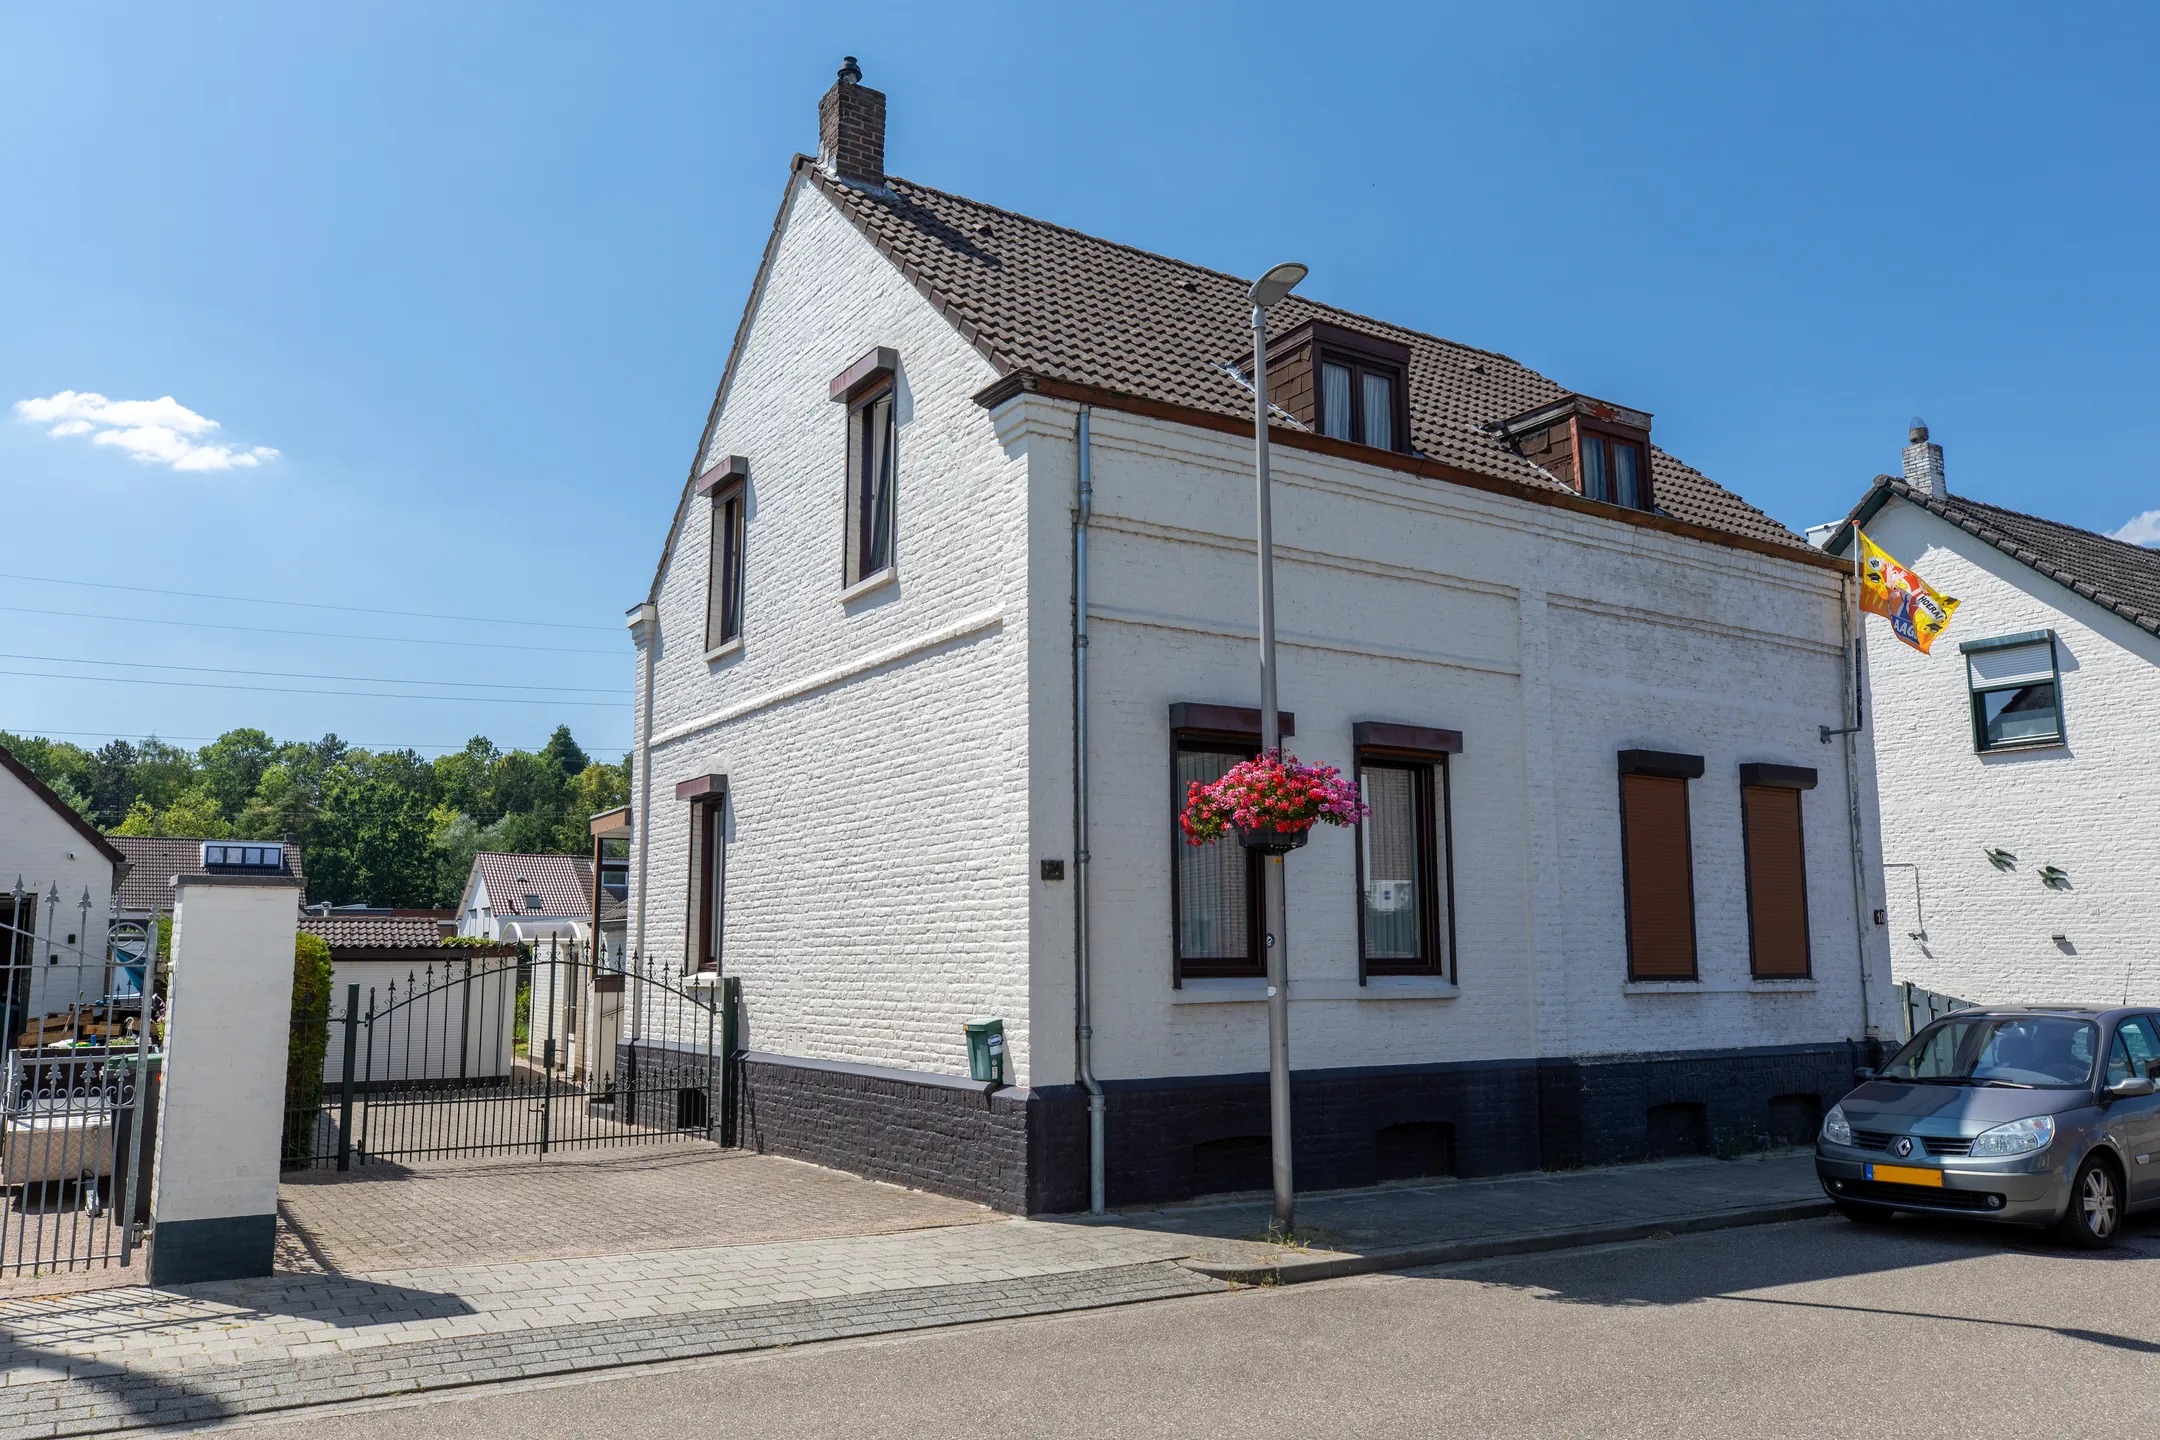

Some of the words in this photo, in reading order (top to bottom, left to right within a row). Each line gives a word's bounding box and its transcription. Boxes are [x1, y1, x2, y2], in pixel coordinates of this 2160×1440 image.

[1918, 595, 1944, 620] HOERA!
[1894, 619, 1918, 640] AAG
[1877, 911, 1886, 924] 10
